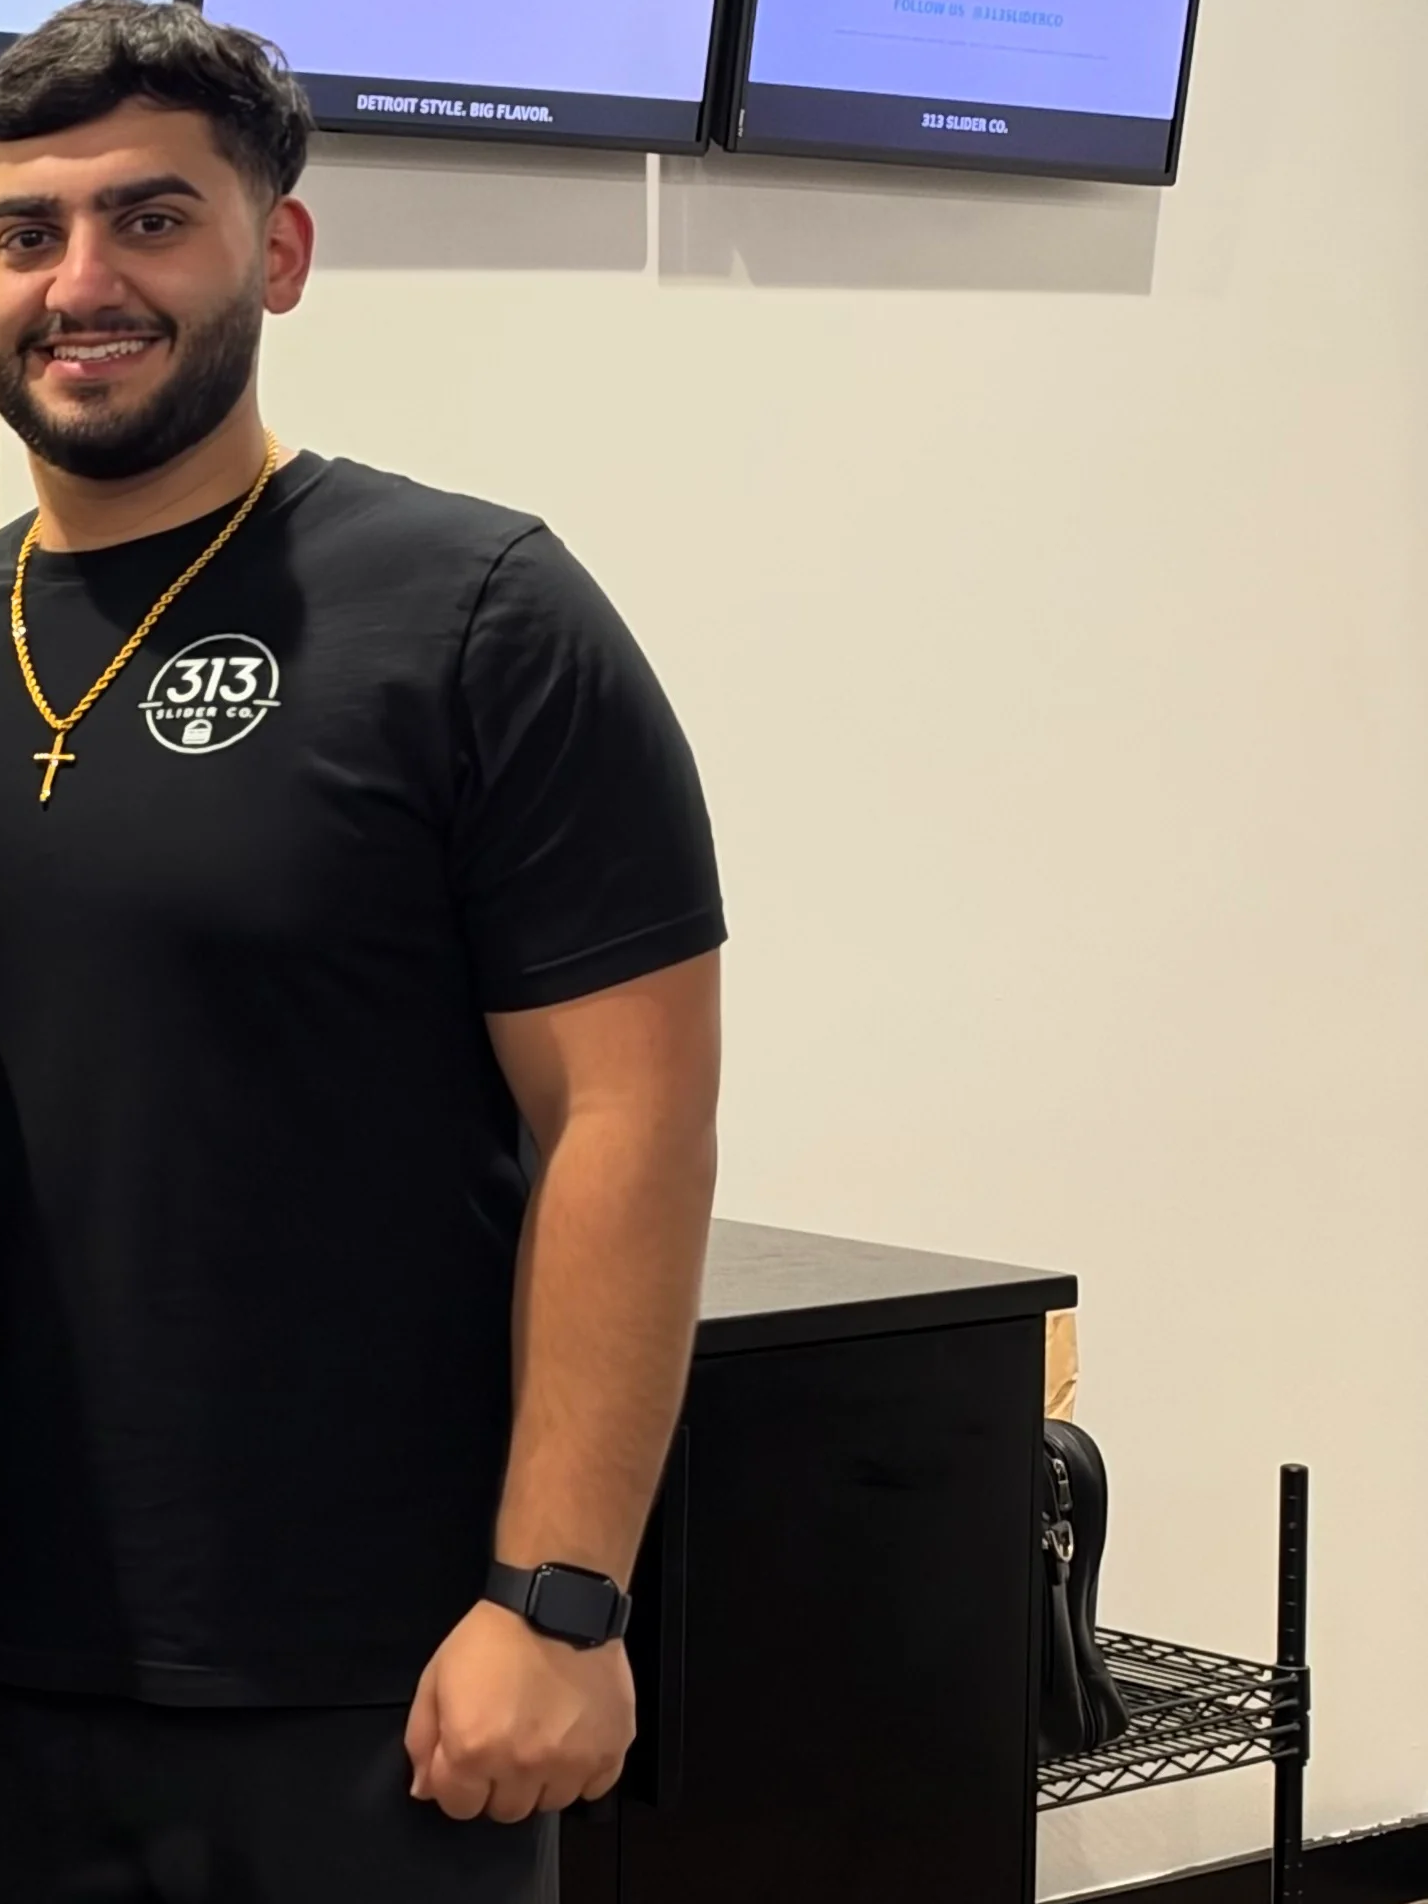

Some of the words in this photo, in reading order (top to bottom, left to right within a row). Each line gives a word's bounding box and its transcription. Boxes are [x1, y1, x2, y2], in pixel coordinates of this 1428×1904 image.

[921, 113, 944, 128] 313
[945, 115, 986, 132] SLIDER
[988, 119, 1008, 133] CO.
[166, 658, 263, 703] 313
[156, 707, 217, 720] SLIDER
[226, 707, 254, 718] CO.
